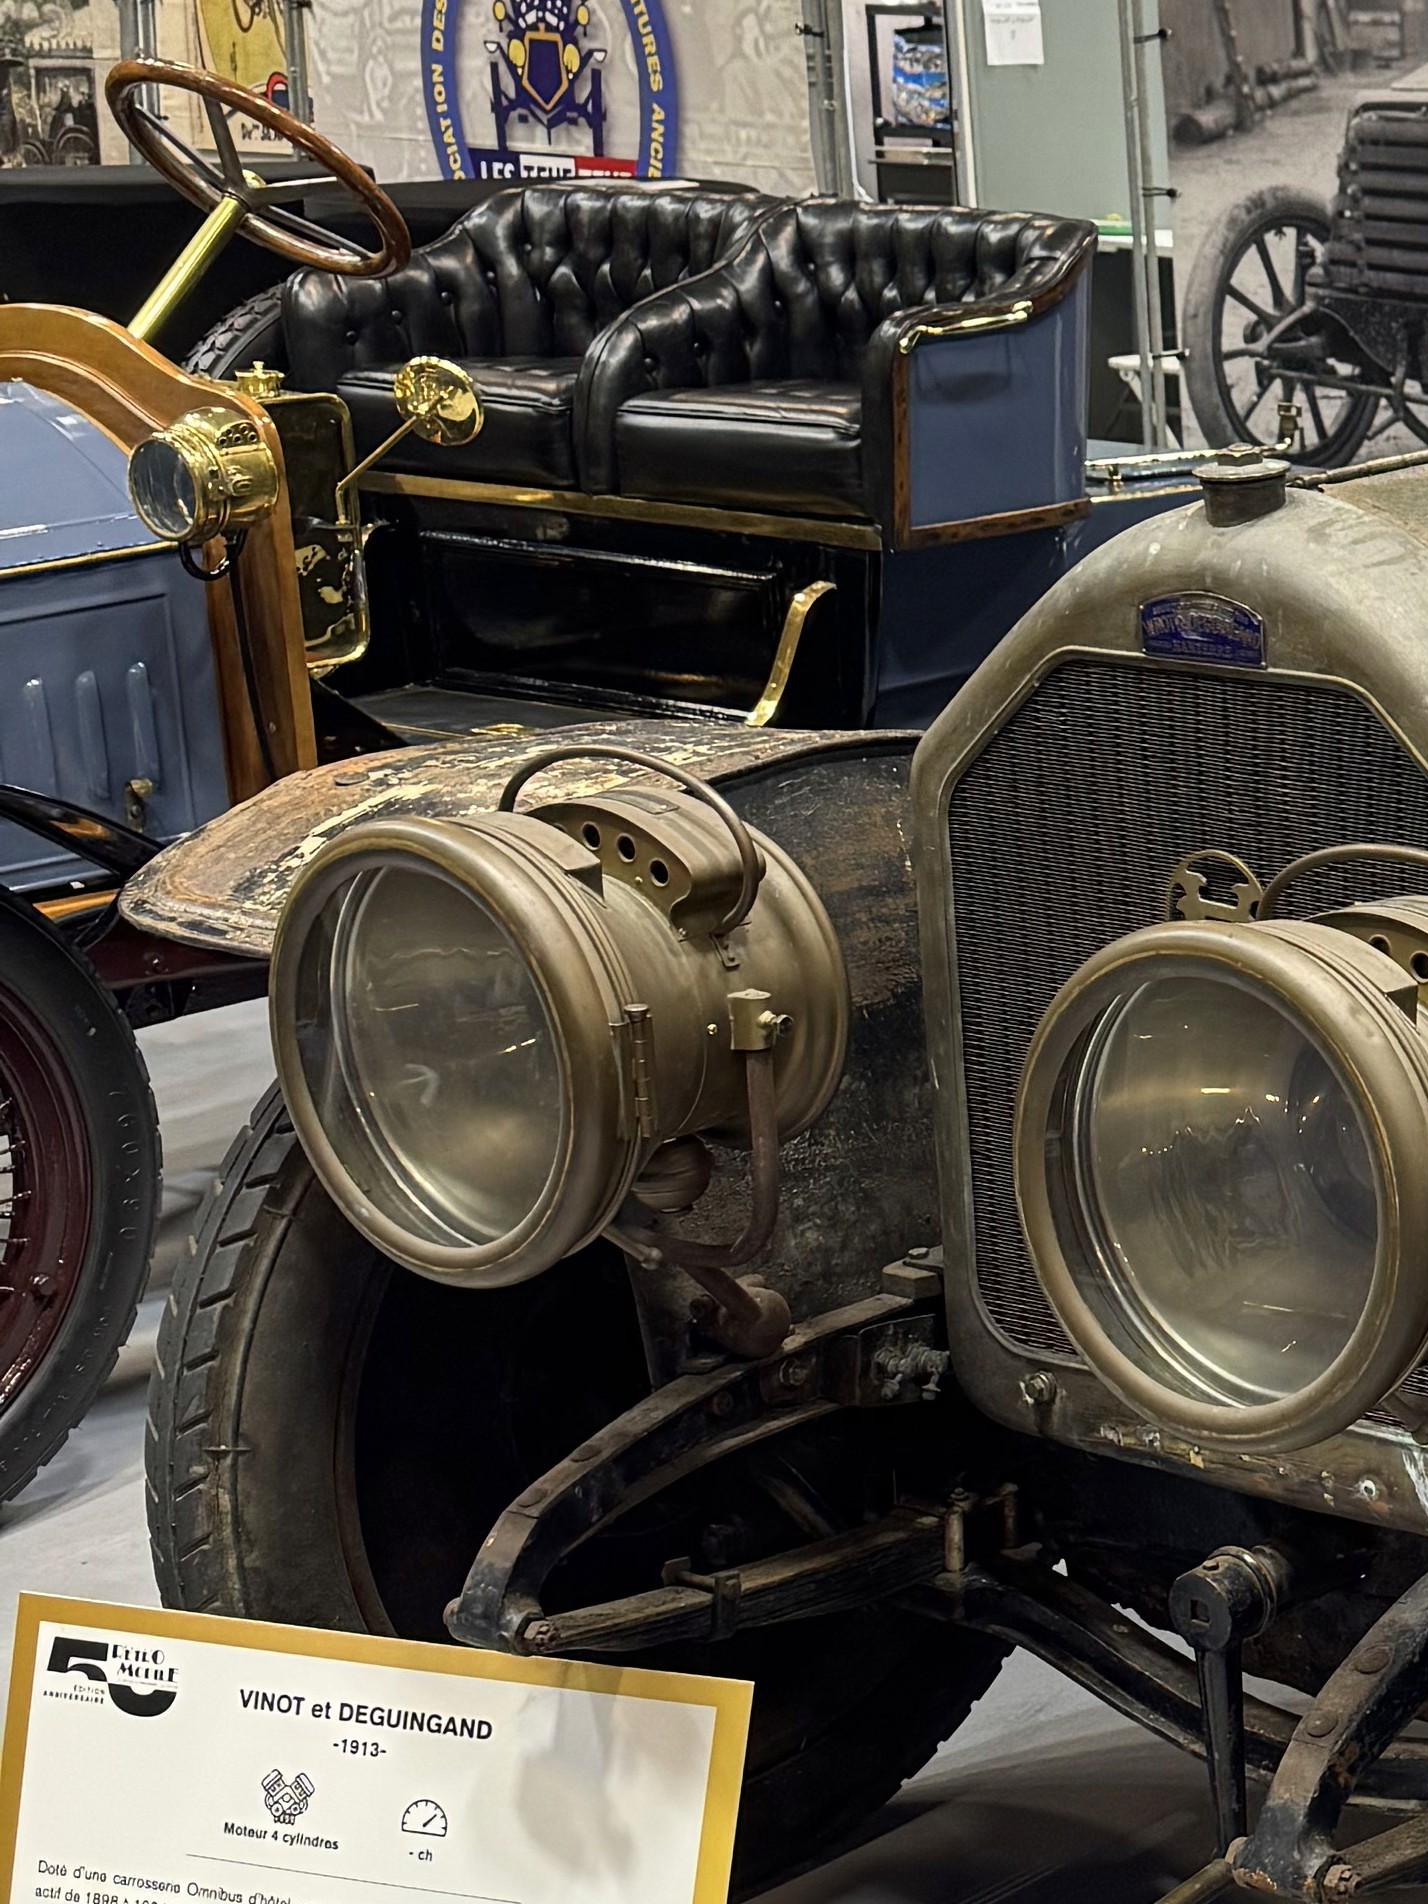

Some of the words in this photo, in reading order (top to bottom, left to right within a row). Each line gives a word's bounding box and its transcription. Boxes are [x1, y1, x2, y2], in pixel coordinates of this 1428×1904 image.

[240, 1688, 306, 1716] VINOT
[311, 1700, 332, 1720] et
[339, 1702, 493, 1740] DEGUINGAND
[333, 1738, 388, 1757] -1913-
[224, 1821, 268, 1841] Moteur
[271, 1830, 279, 1841] 4
[282, 1831, 340, 1850] cylindres
[418, 1848, 434, 1862] ch
[38, 1860, 67, 1877] Doté
[113, 1874, 180, 1894] carrosserie
[187, 1882, 242, 1904] Omnibus
[35, 1887, 61, 1900] actif
[64, 1889, 80, 1903] de
